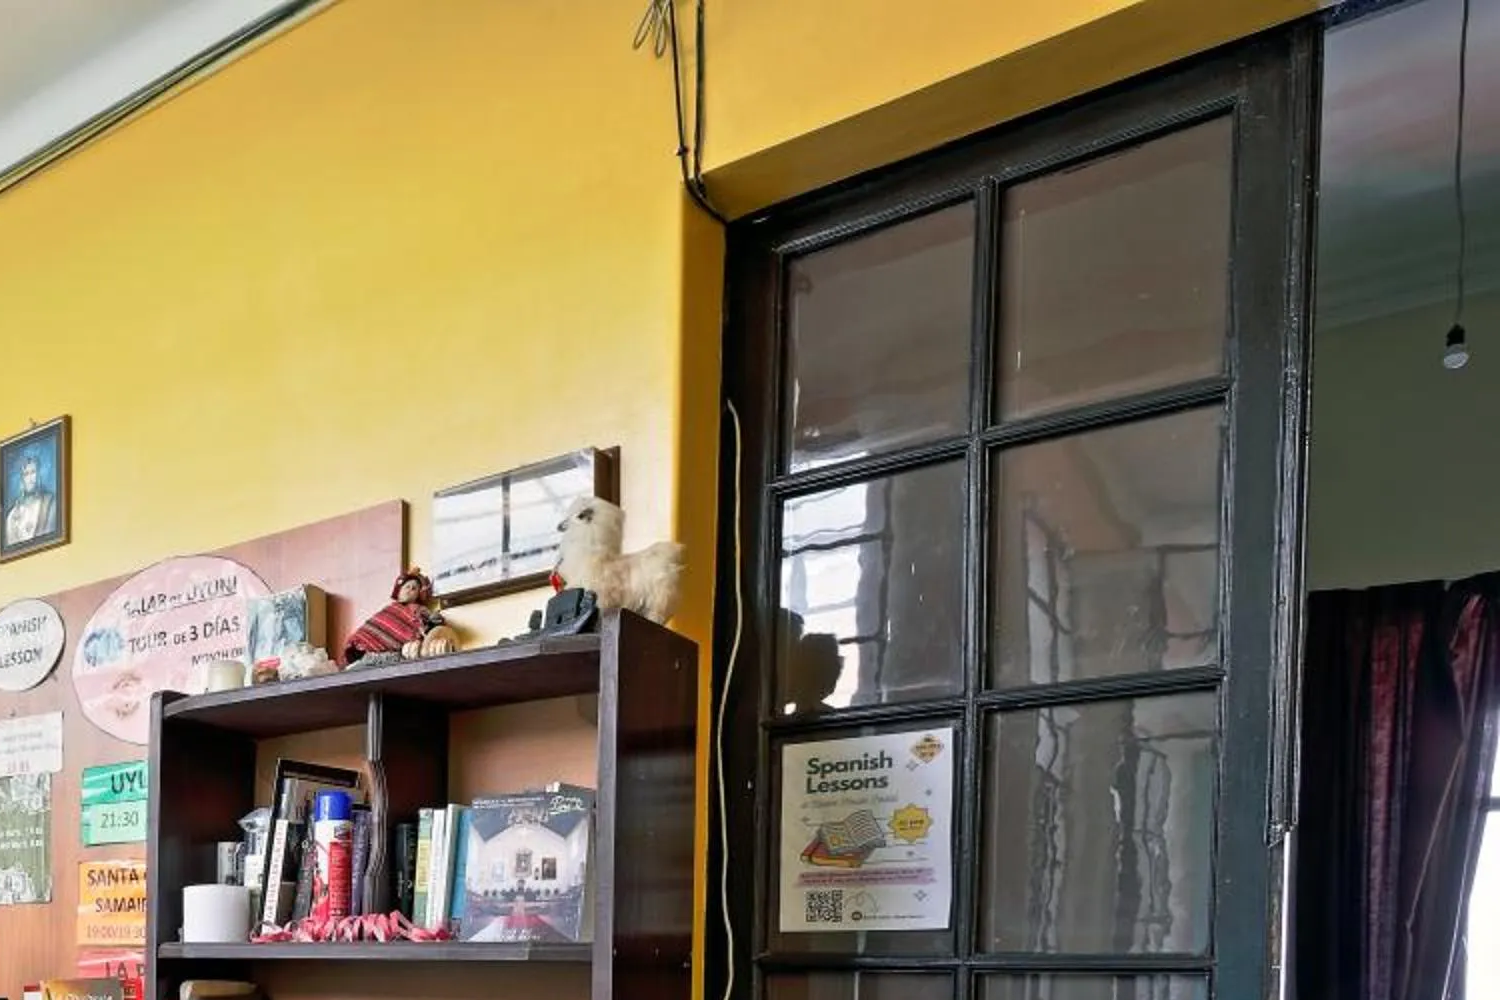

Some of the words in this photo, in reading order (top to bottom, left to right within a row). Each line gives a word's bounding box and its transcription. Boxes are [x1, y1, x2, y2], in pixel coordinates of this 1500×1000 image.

[129, 631, 167, 653] TOUR
[189, 625, 199, 641] 3
[203, 615, 240, 639] DÍAS
[806, 750, 893, 779] Spanish
[111, 771, 148, 794] UYU
[806, 774, 889, 794] Lessons
[101, 811, 139, 829] 21:30
[87, 868, 139, 886] SANTA
[95, 896, 148, 913] SAMAI
